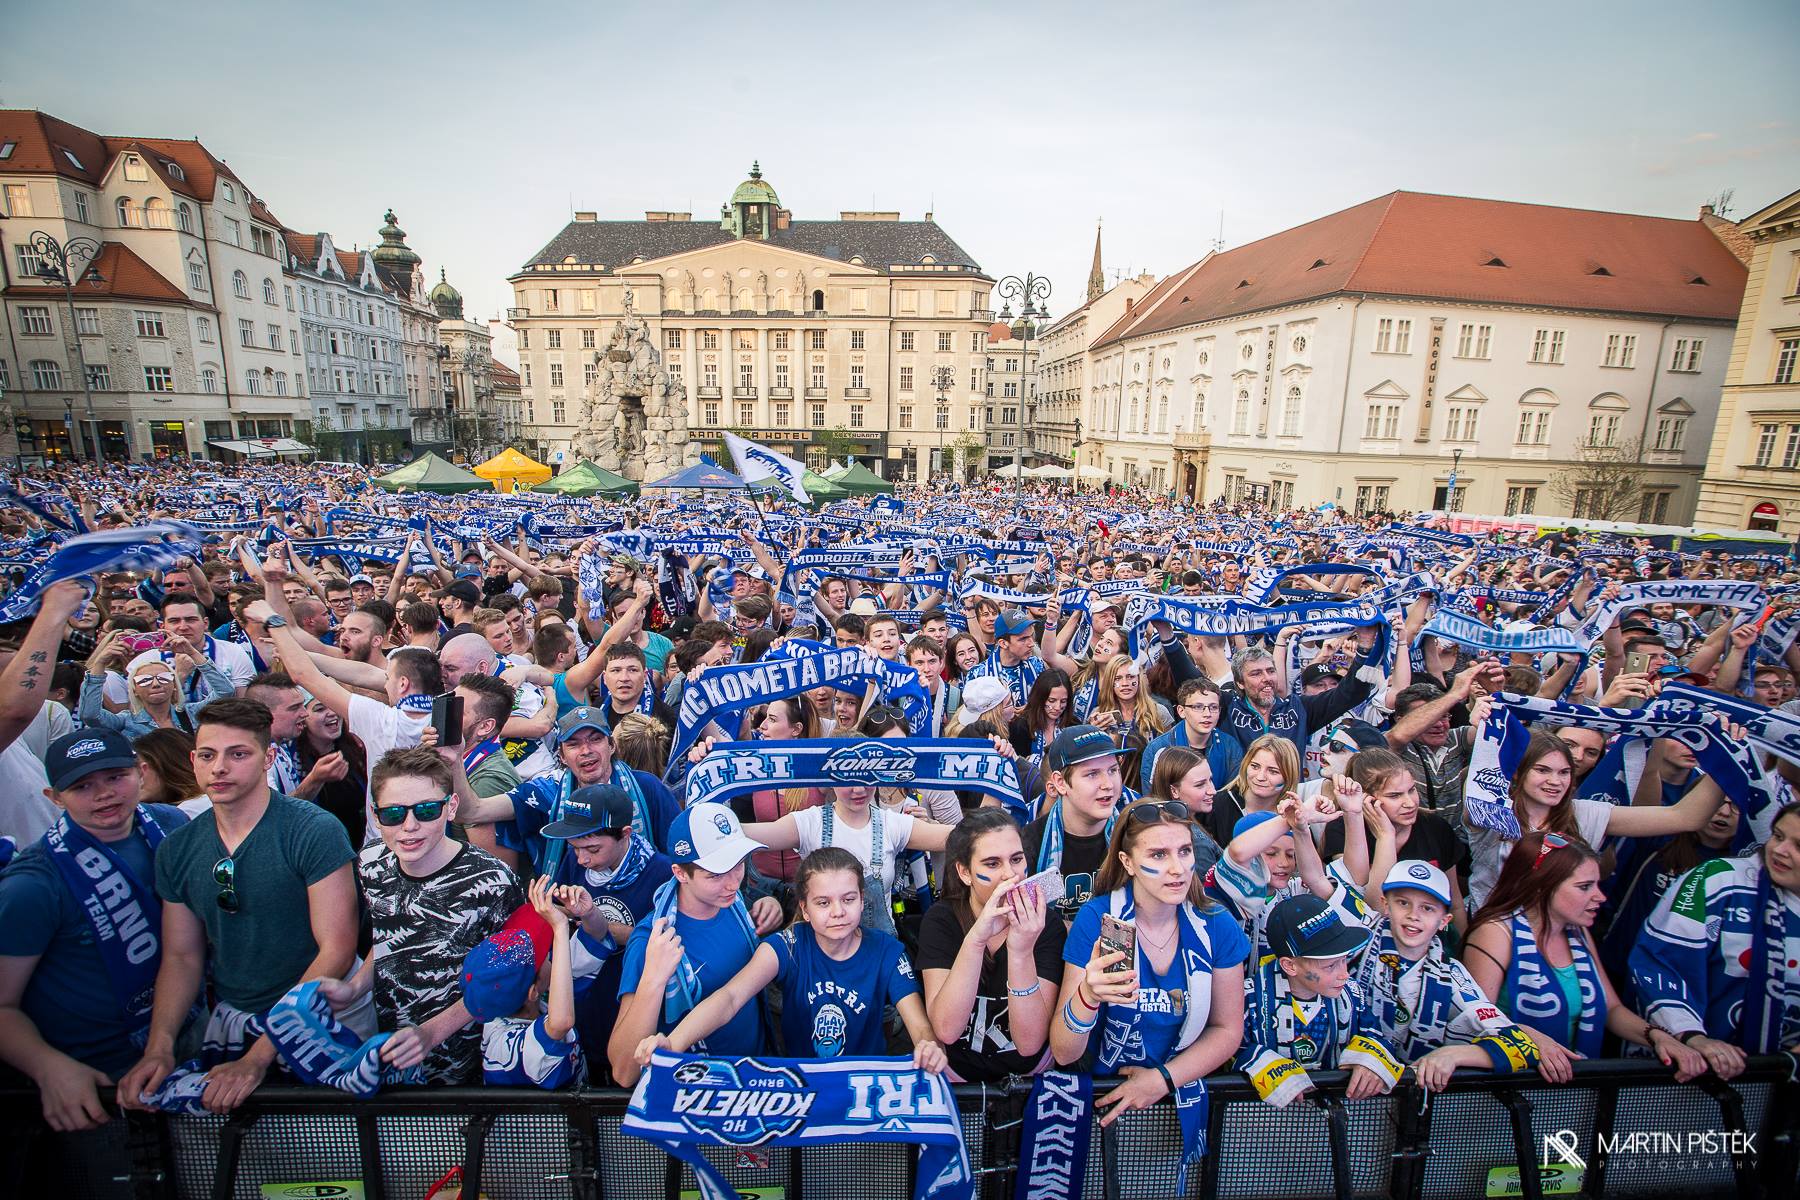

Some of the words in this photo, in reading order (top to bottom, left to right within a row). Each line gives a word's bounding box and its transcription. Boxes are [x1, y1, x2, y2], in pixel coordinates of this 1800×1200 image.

[1262, 340, 1275, 406] Reduta
[1425, 336, 1441, 408] Reduta
[765, 432, 809, 440] HOTEL
[963, 535, 1023, 550] KOMETA
[1093, 580, 1141, 594] KOMETA
[1640, 583, 1752, 601] KOMETA
[1164, 604, 1192, 628] HC
[1194, 611, 1300, 634] KOMETA
[1438, 612, 1515, 647] KOMETA
[1521, 628, 1576, 648] BRNO
[677, 688, 705, 728] HC
[701, 655, 820, 709] KOMETA
[823, 650, 887, 681] BRNO
[822, 756, 917, 772] KOMETA
[75, 846, 158, 965] BRNO
[602, 897, 624, 911] FOND
[84, 892, 116, 942] TEAM
[1139, 987, 1171, 1004] ETA
[816, 1015, 845, 1028] PLAY
[820, 1025, 839, 1037] OFF
[748, 1078, 785, 1089] BRNO
[672, 1089, 817, 1118] KOMETA
[721, 1119, 748, 1134] HC
